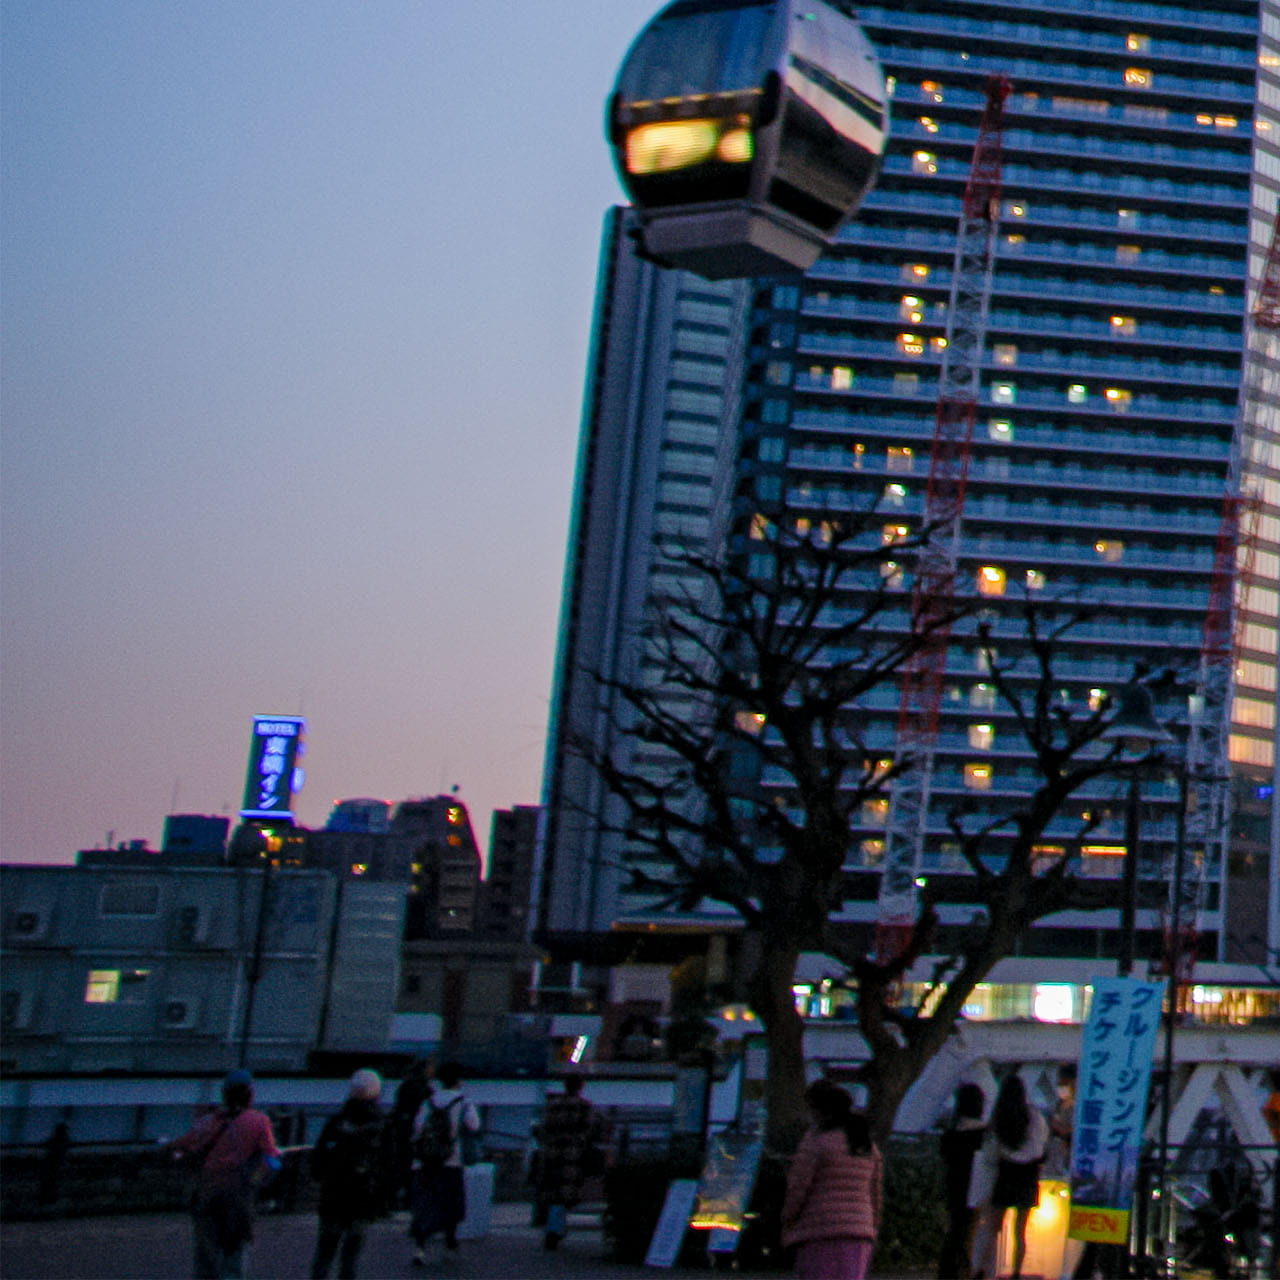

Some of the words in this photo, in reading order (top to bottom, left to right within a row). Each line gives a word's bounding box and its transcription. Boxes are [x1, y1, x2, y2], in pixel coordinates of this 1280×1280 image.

[1107, 987, 1154, 1152] クルージング
